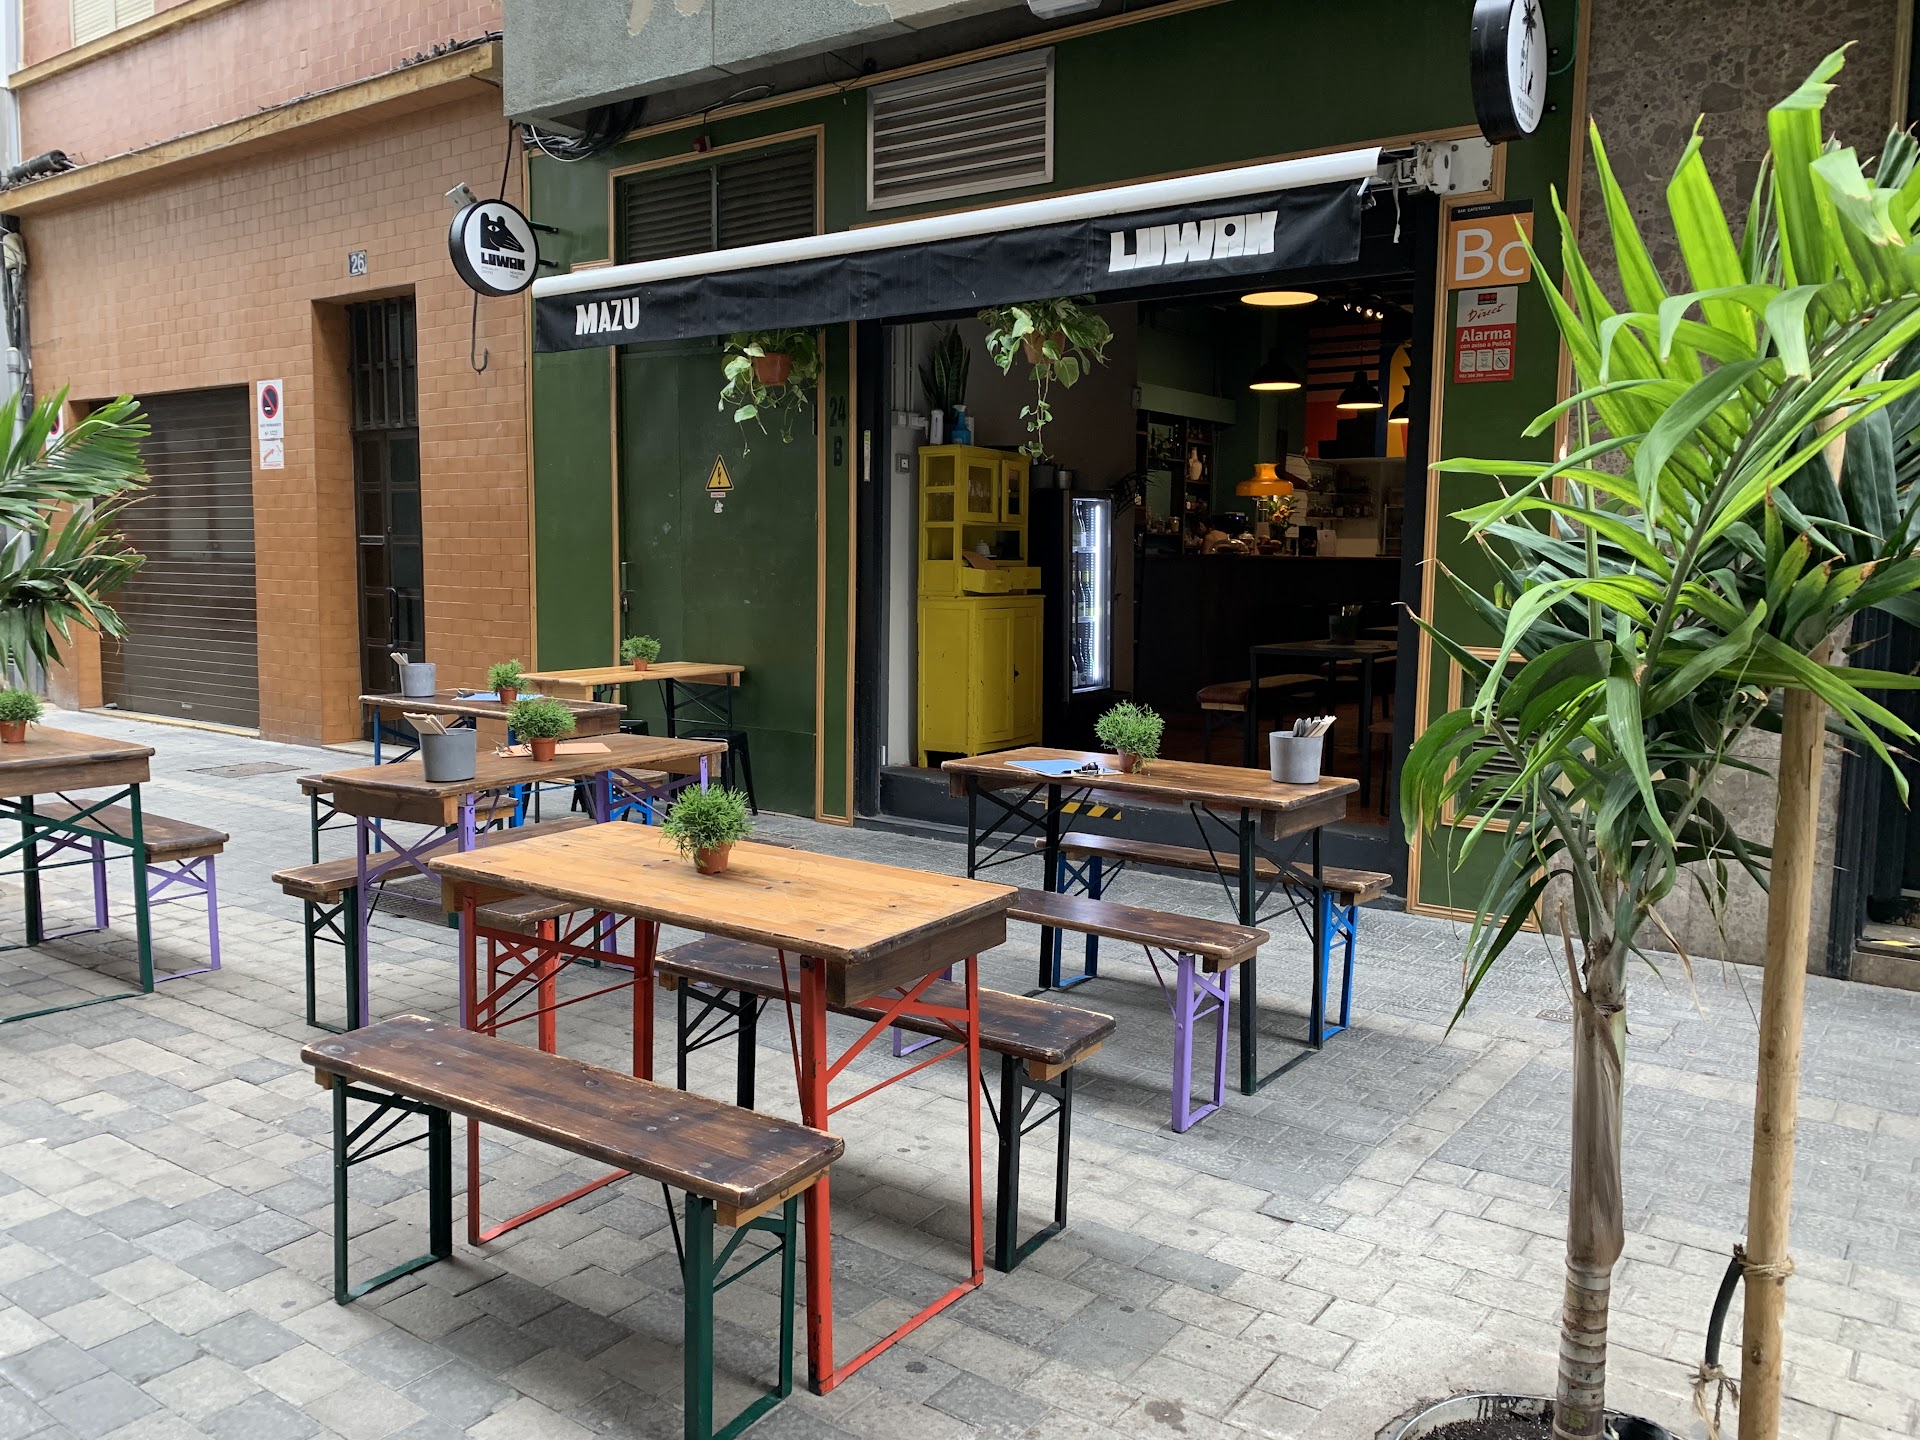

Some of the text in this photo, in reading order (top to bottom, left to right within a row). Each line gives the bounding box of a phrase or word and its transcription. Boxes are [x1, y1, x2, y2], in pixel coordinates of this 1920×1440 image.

[1108, 210, 1278, 272] LUWAK
[1455, 228, 1526, 281] Bc
[351, 253, 365, 273] 26
[481, 252, 526, 271] LUWAK
[575, 297, 640, 335] MAZU
[1468, 303, 1507, 322] Direct
[1461, 329, 1511, 342] Alarma
[830, 395, 846, 428] 24
[834, 435, 842, 466] B
